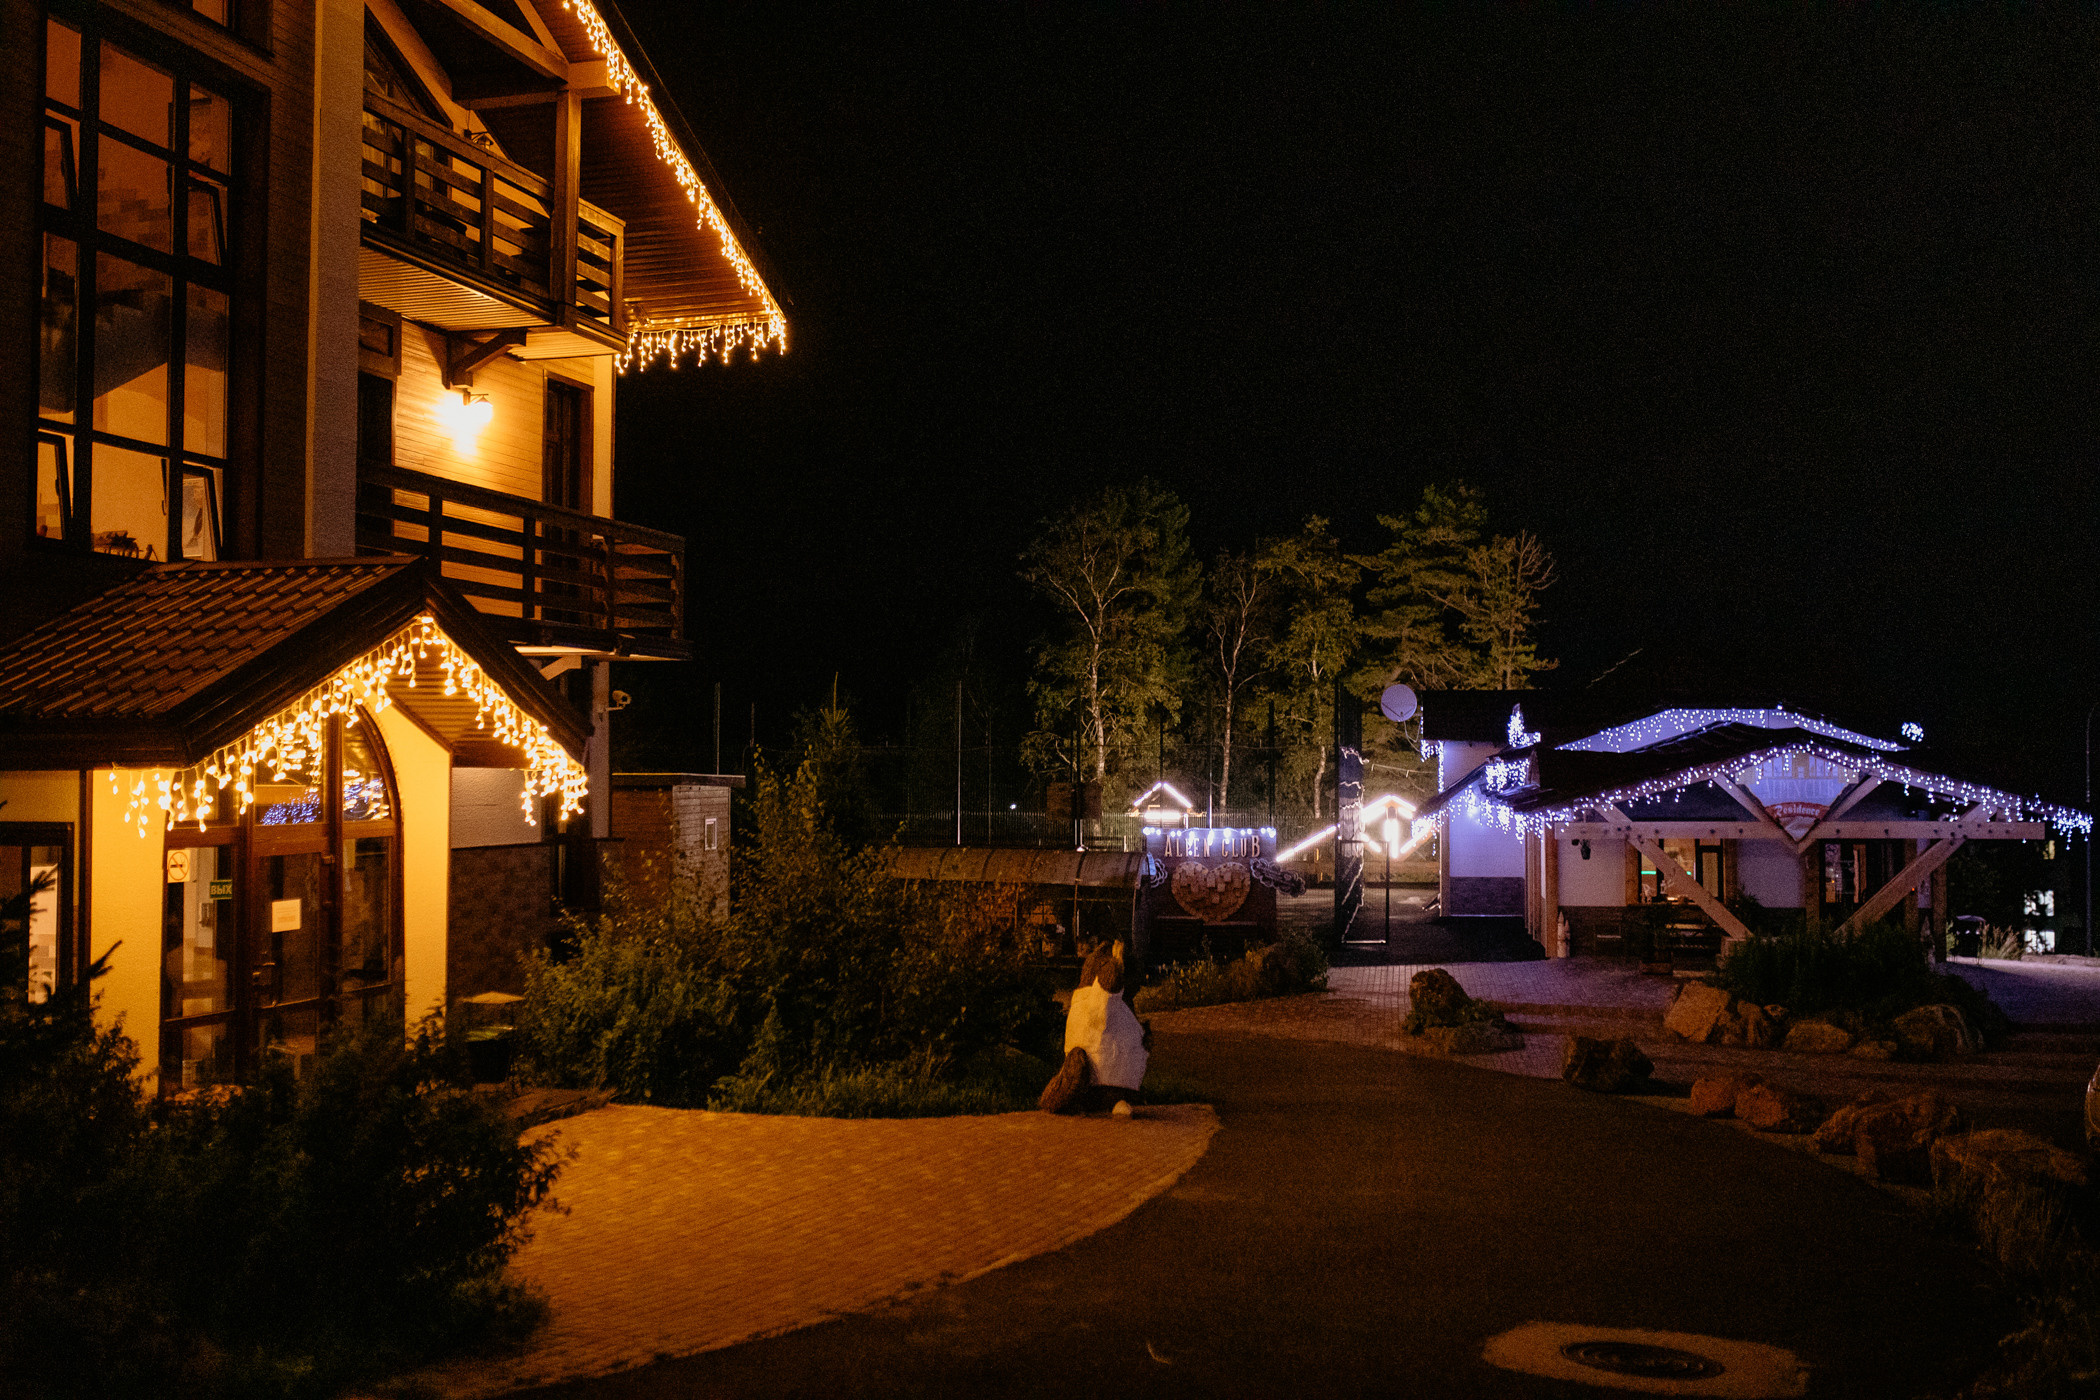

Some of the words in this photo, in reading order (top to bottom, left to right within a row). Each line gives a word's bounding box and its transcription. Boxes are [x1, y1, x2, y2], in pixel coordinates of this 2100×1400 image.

[1773, 804, 1821, 817] Residence
[1164, 834, 1211, 858] ALPEN
[1221, 834, 1261, 858] CLUB
